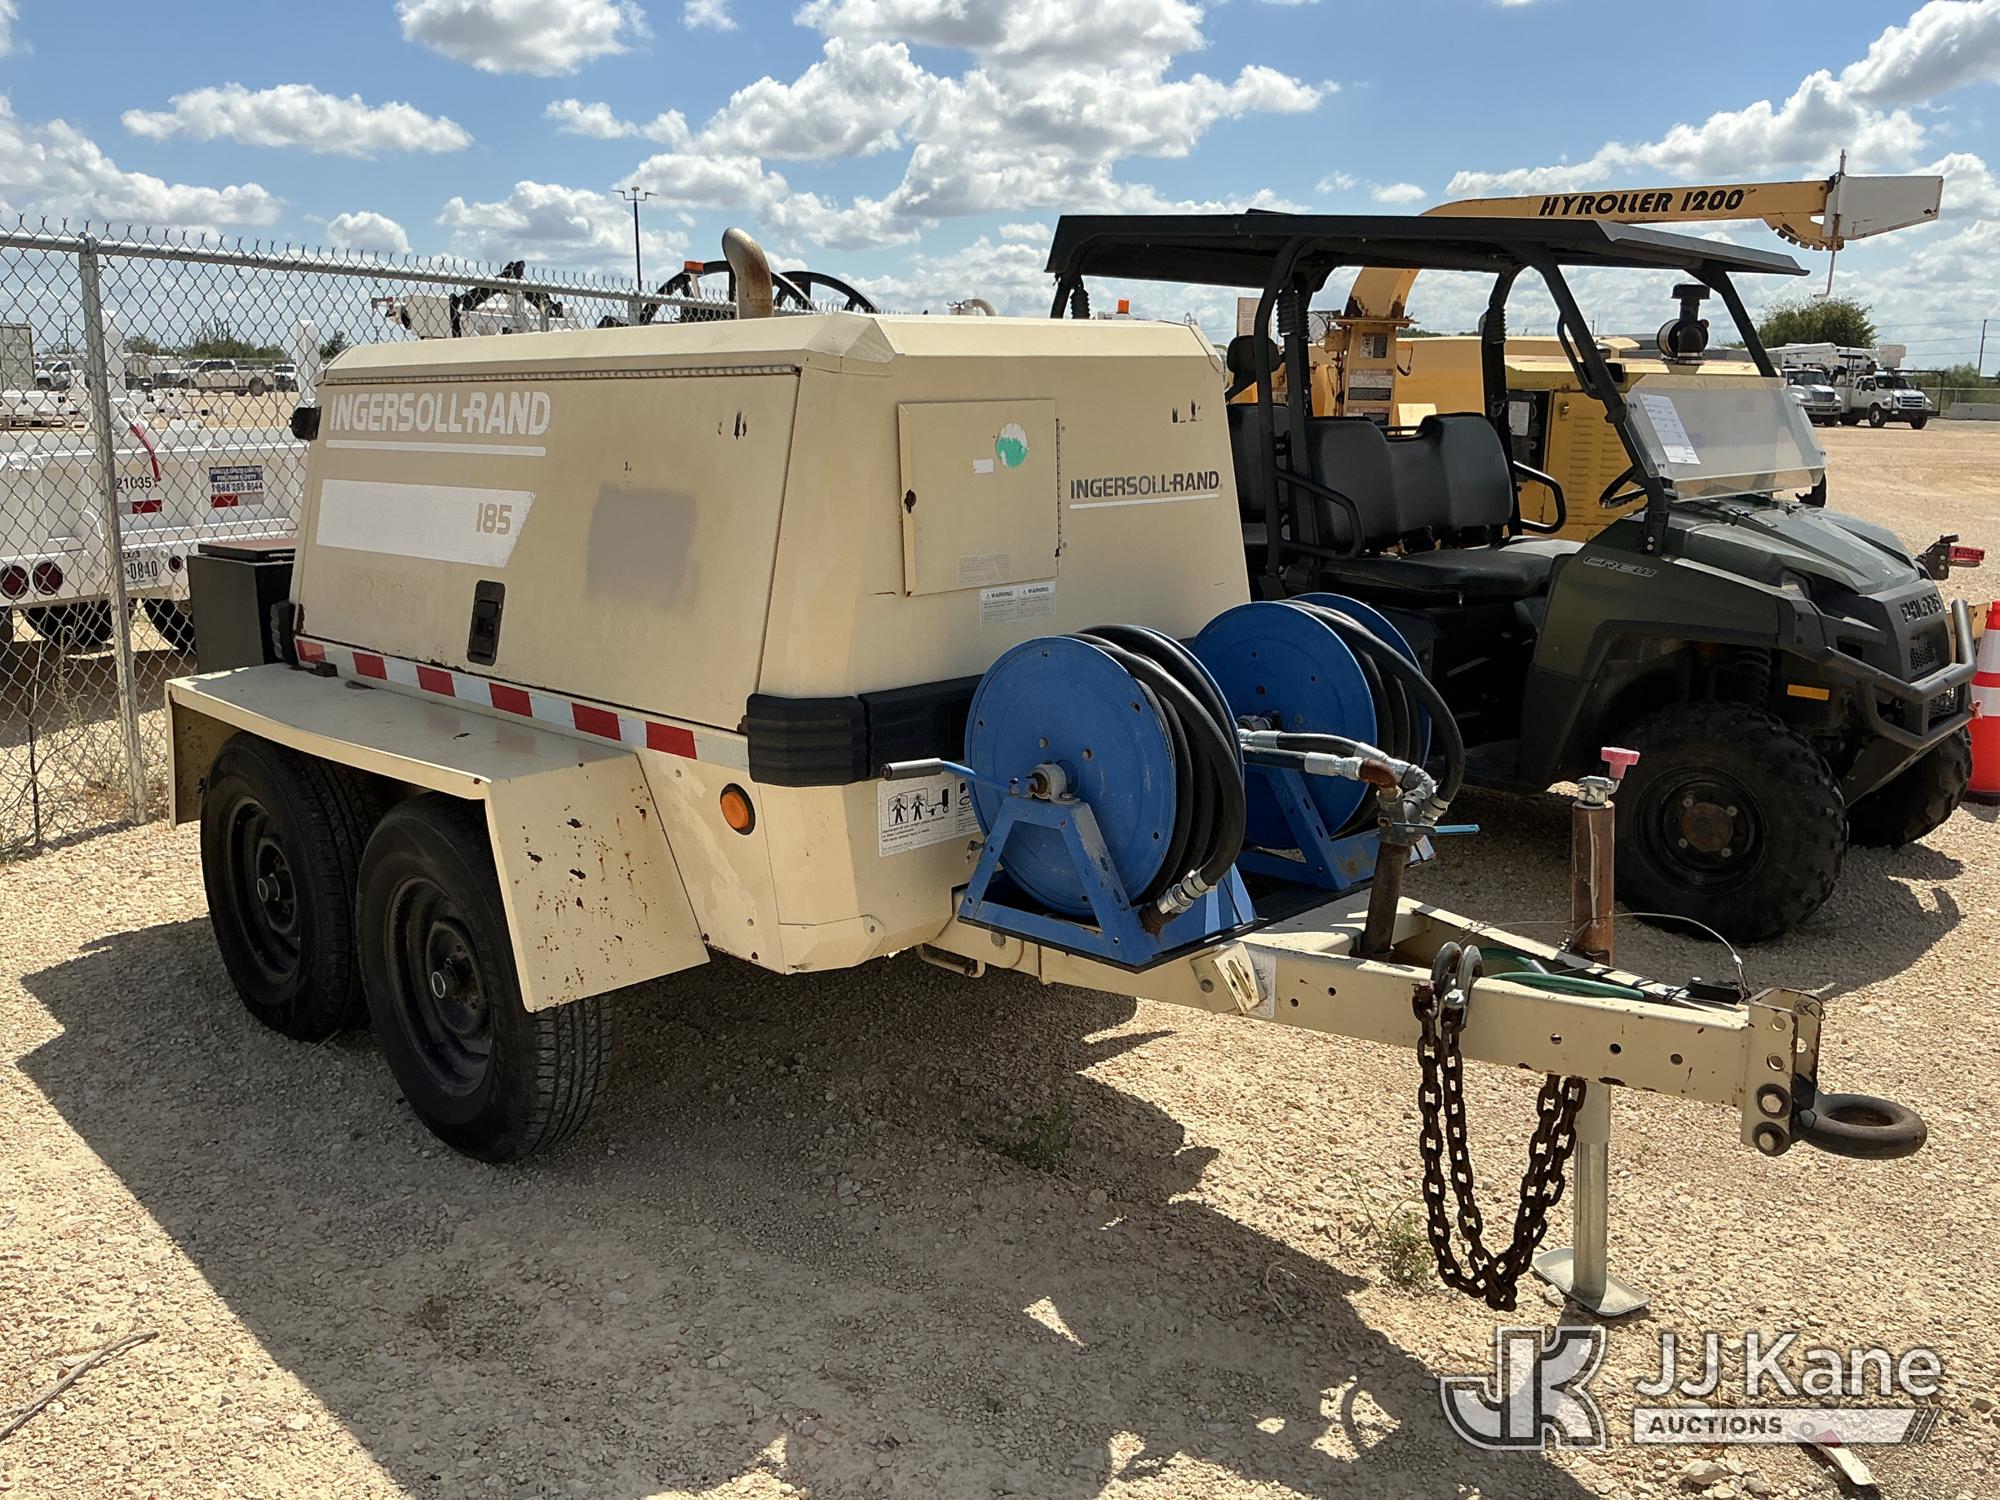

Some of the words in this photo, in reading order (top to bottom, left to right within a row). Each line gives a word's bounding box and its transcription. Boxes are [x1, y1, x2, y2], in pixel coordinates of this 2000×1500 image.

[1538, 192, 1674, 217] HYROLLER
[1680, 188, 1745, 212] 1200
[329, 391, 551, 436] INGERSOLL-RAND
[1070, 470, 1220, 499] INGERSOLL-RAND
[475, 502, 512, 536] 185
[1583, 555, 1658, 577] CREW
[991, 590, 1014, 598] WARNING
[1027, 586, 1050, 594] WARNING
